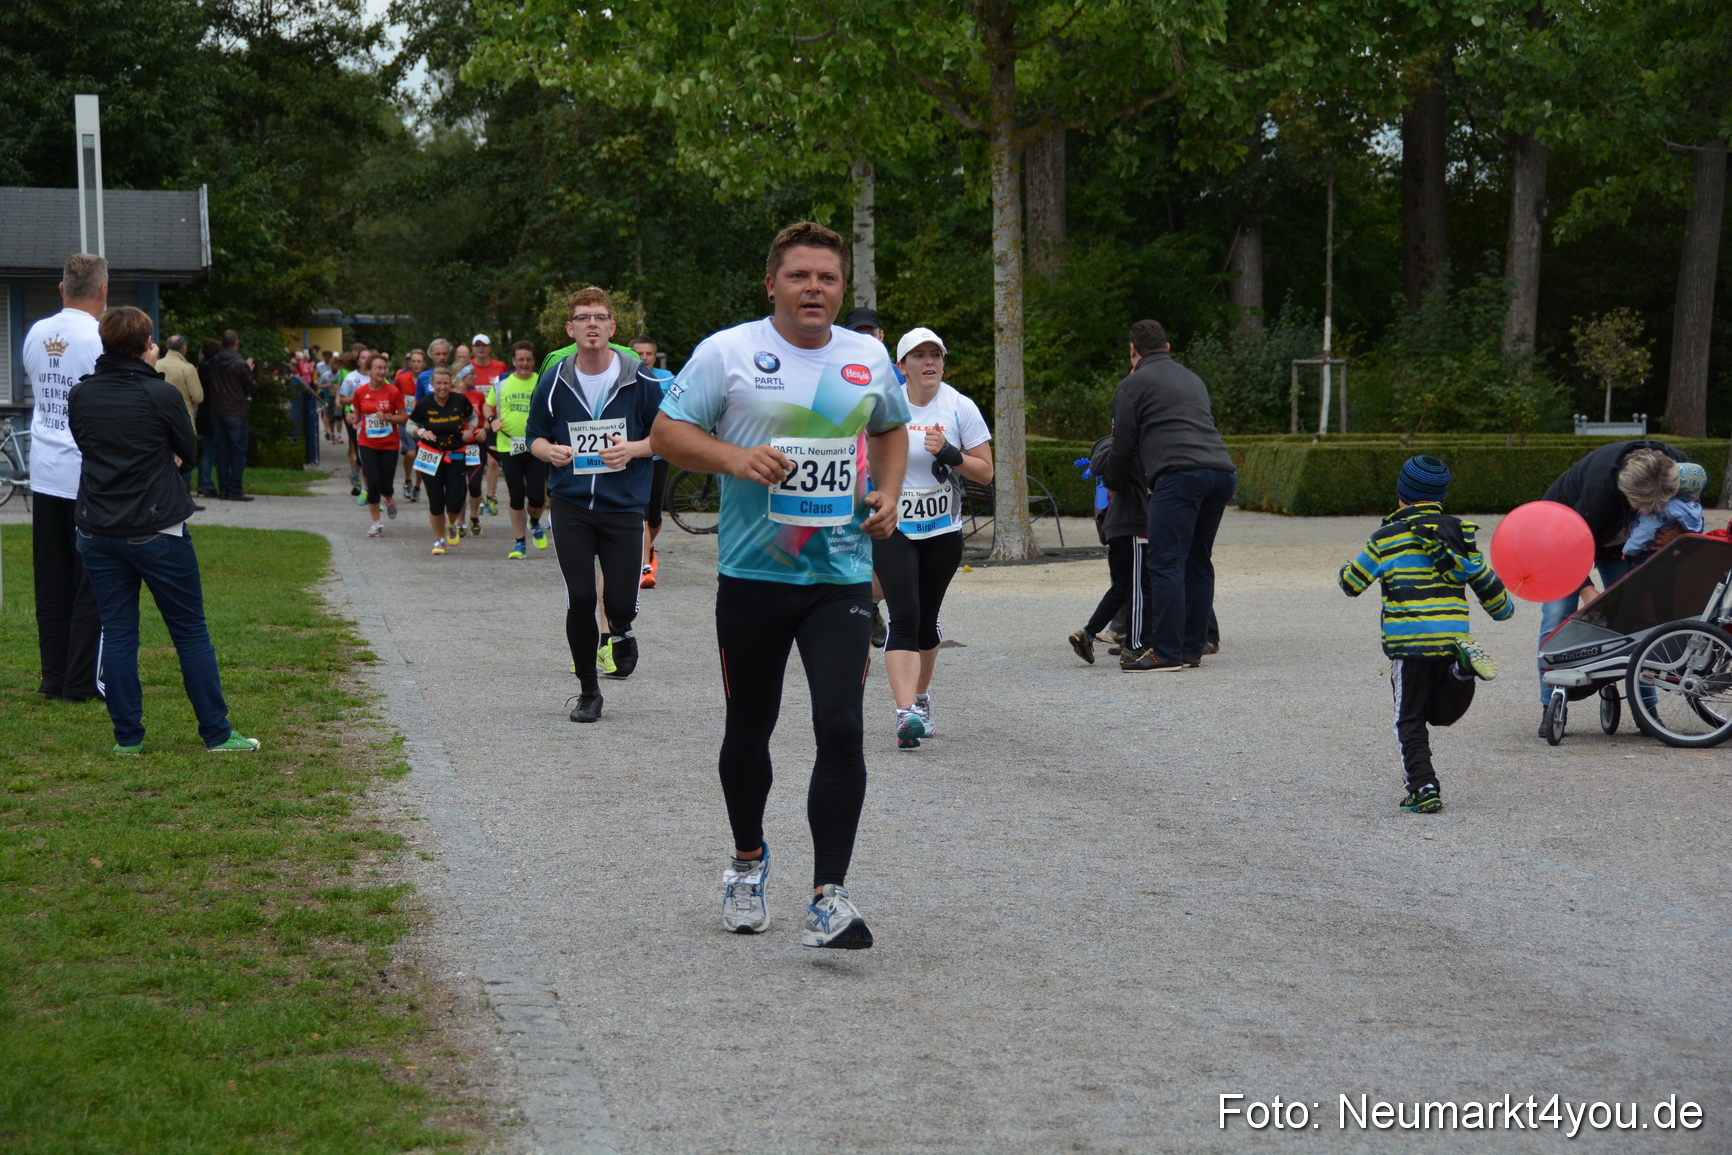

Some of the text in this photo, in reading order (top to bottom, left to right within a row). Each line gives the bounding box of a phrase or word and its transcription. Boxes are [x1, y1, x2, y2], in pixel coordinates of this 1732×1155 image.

[50, 358, 60, 368] IM
[754, 376, 785, 385] PARTL
[845, 367, 869, 381] Hervis
[42, 387, 69, 401] SEINER
[44, 417, 66, 431] JESUS
[773, 445, 847, 455] PARTL Neumarkt
[780, 459, 851, 492] 2345
[800, 500, 833, 514] Claus
[902, 495, 948, 519] 2400
[917, 521, 936, 532] Birgit
[1555, 646, 1598, 661] chariot
